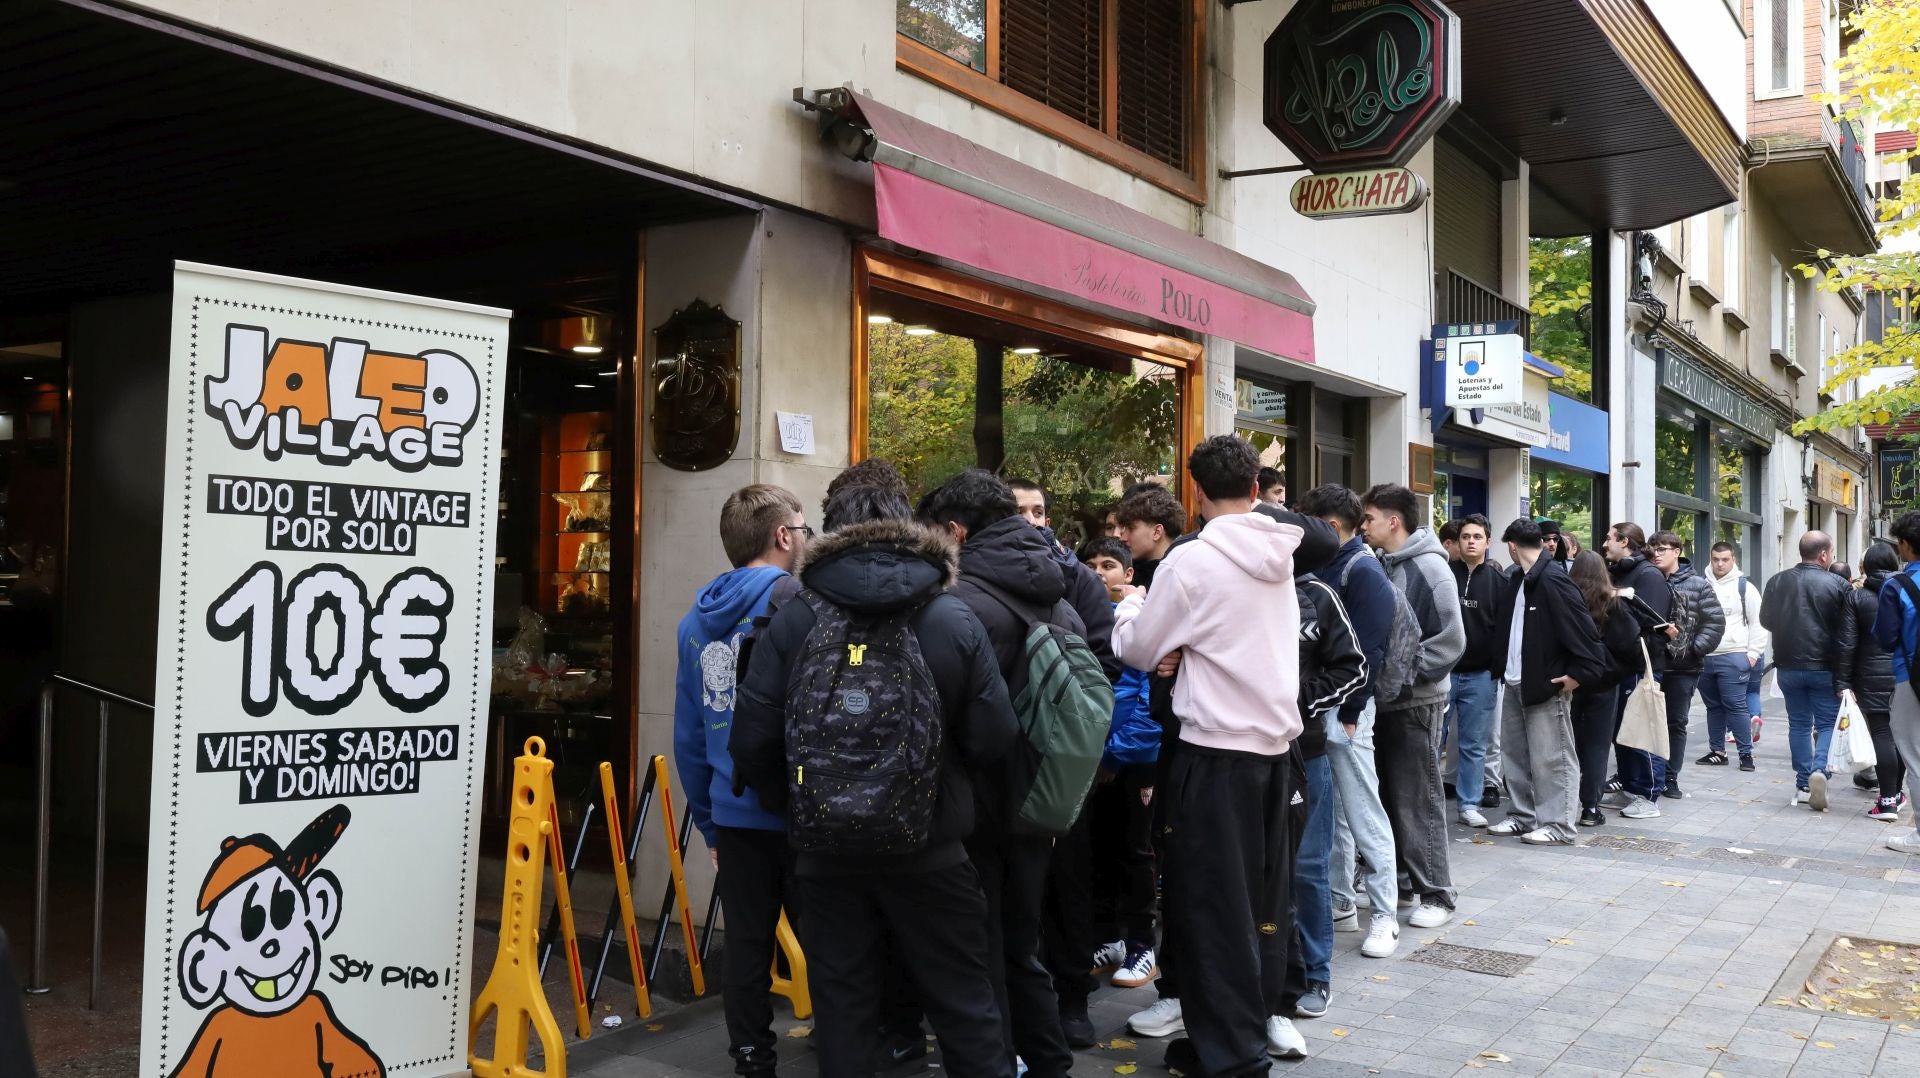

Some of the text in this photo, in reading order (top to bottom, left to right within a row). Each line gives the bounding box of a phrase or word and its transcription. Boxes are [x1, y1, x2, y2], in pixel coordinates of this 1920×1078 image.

[1297, 172, 1410, 212] HORCHATA
[1160, 277, 1212, 327] POLO
[204, 323, 482, 434] JALEO
[1214, 388, 1233, 404] VENTA
[1458, 385, 1491, 393] Apuestas
[1458, 392, 1482, 400] Estado
[1488, 377, 1493, 385] y
[1523, 401, 1542, 423] Estado
[222, 400, 464, 470] VILLAGE
[212, 478, 467, 526] TODO EL VINTAGE
[271, 515, 413, 553] POR SOLO
[206, 560, 454, 716] 10€
[203, 729, 454, 769] VIERNES SABADO
[245, 762, 416, 800] Y DOMINGO!
